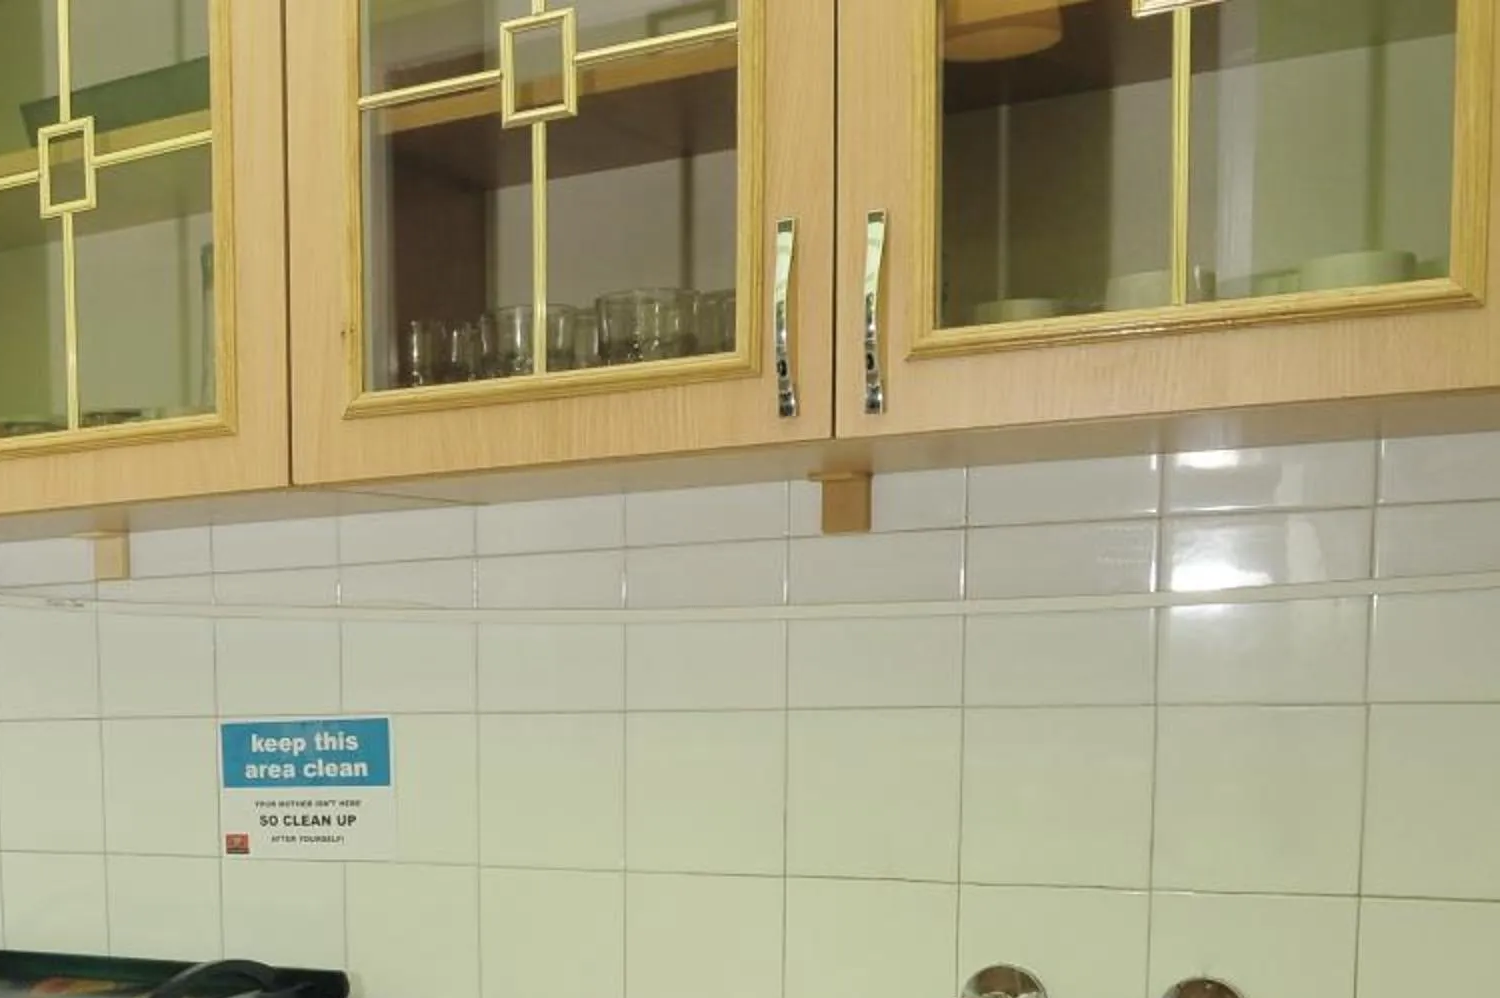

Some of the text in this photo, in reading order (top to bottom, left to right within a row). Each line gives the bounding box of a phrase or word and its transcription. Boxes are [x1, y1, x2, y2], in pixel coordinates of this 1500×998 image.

[251, 731, 359, 756] keep this
[245, 759, 368, 779] area clean
[259, 814, 357, 827] SO CLEAN UP
